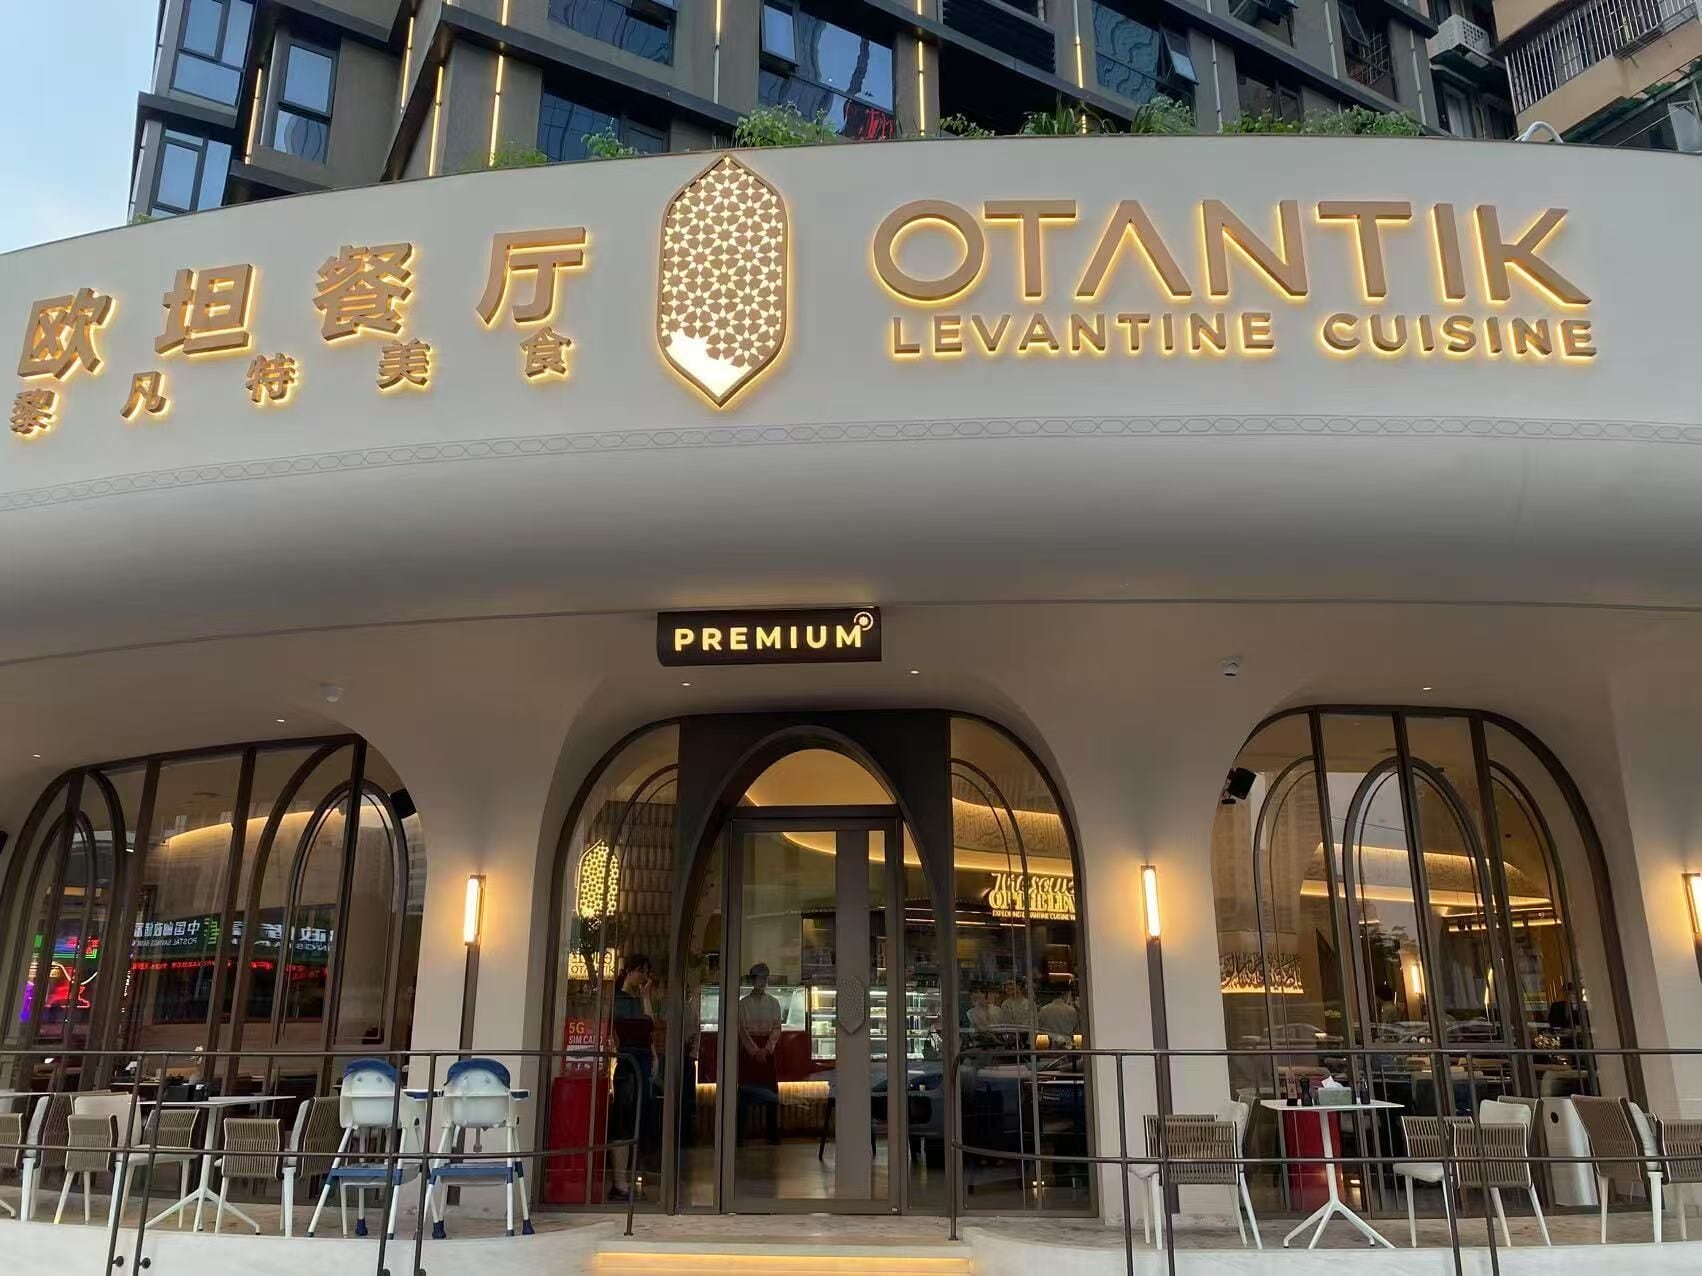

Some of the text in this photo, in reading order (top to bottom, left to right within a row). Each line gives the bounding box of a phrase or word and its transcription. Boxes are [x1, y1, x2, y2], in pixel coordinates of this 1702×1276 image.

[873, 199, 1592, 306] OTANTIK
[17, 226, 588, 380] 欧坦餐厅
[891, 312, 1597, 358] LEVANTINE CUISINE
[9, 327, 575, 436] 黎凡特美食
[673, 625, 862, 652] PREMIUM
[568, 1021, 585, 1034] 5G
